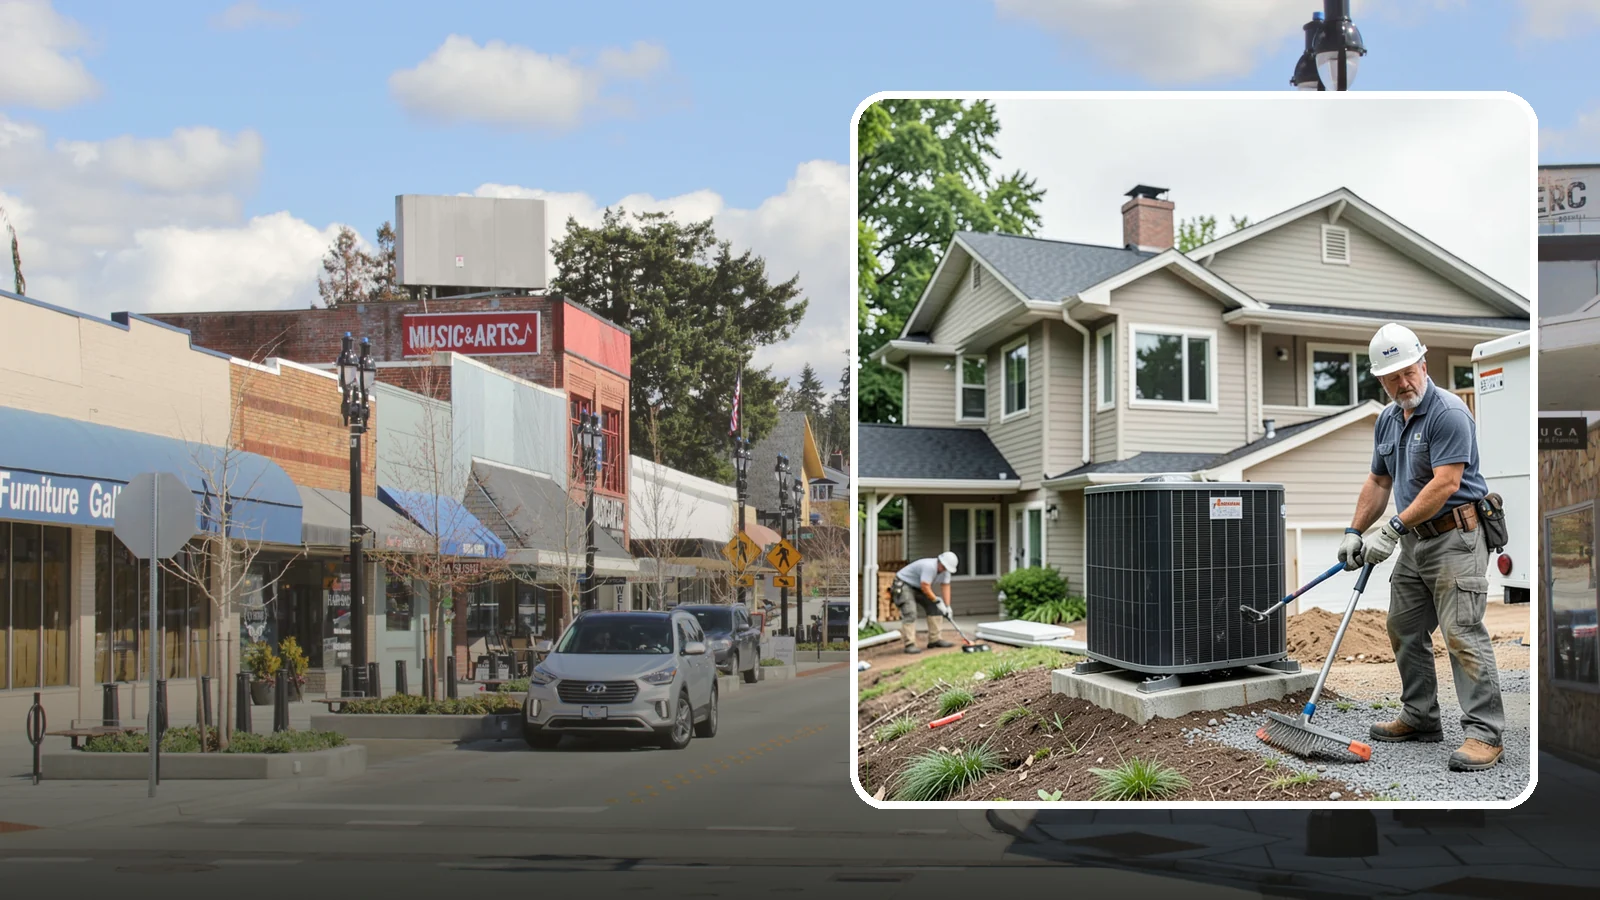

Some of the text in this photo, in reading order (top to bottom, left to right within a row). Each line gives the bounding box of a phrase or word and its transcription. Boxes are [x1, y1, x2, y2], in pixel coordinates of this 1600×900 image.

[409, 323, 519, 349] MUSIC&ARTS
[0, 471, 122, 519] Furniture Gal
